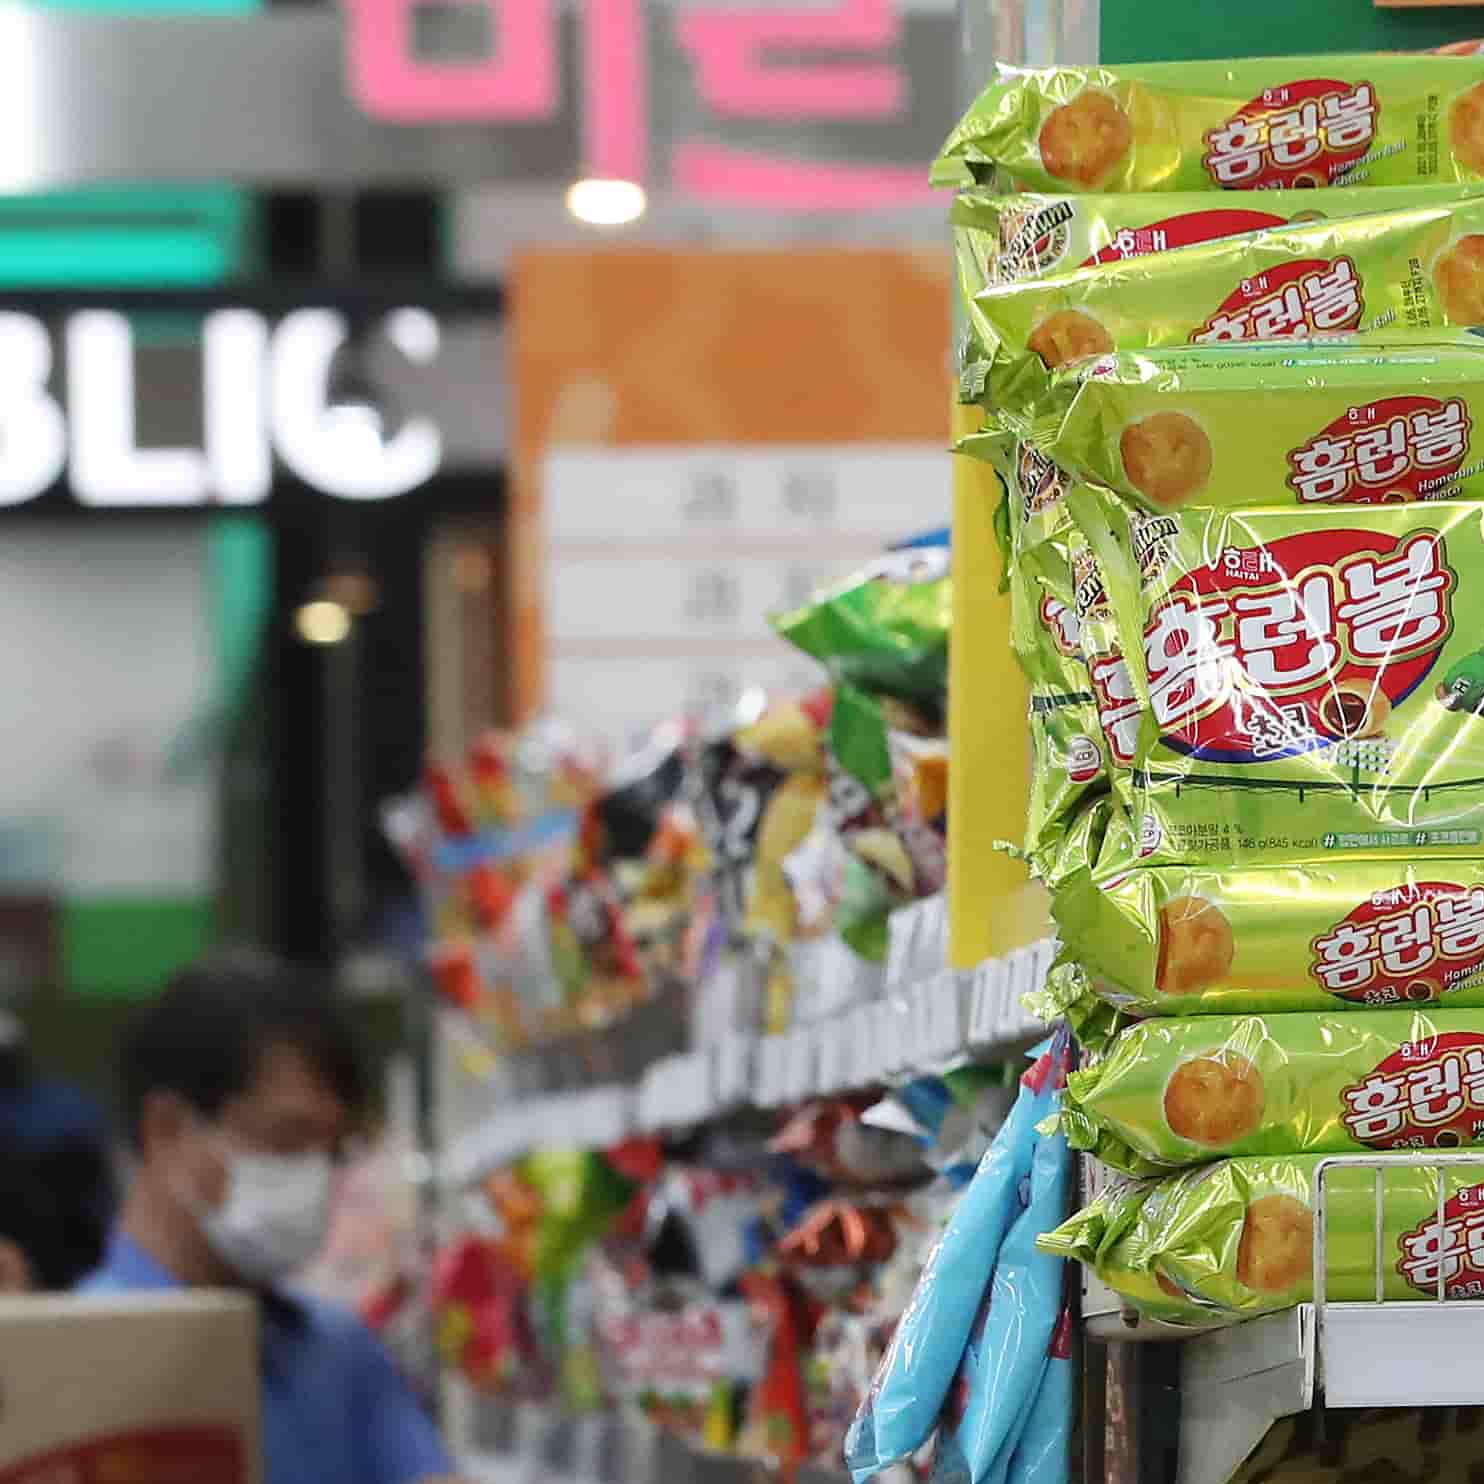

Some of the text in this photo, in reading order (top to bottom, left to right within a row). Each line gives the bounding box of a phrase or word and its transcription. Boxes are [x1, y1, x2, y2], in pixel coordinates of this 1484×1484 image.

[1209, 84, 1375, 182] 홈런볼
[1293, 402, 1466, 500] 홈런볼
[1143, 535, 1437, 726] 홈런볼
